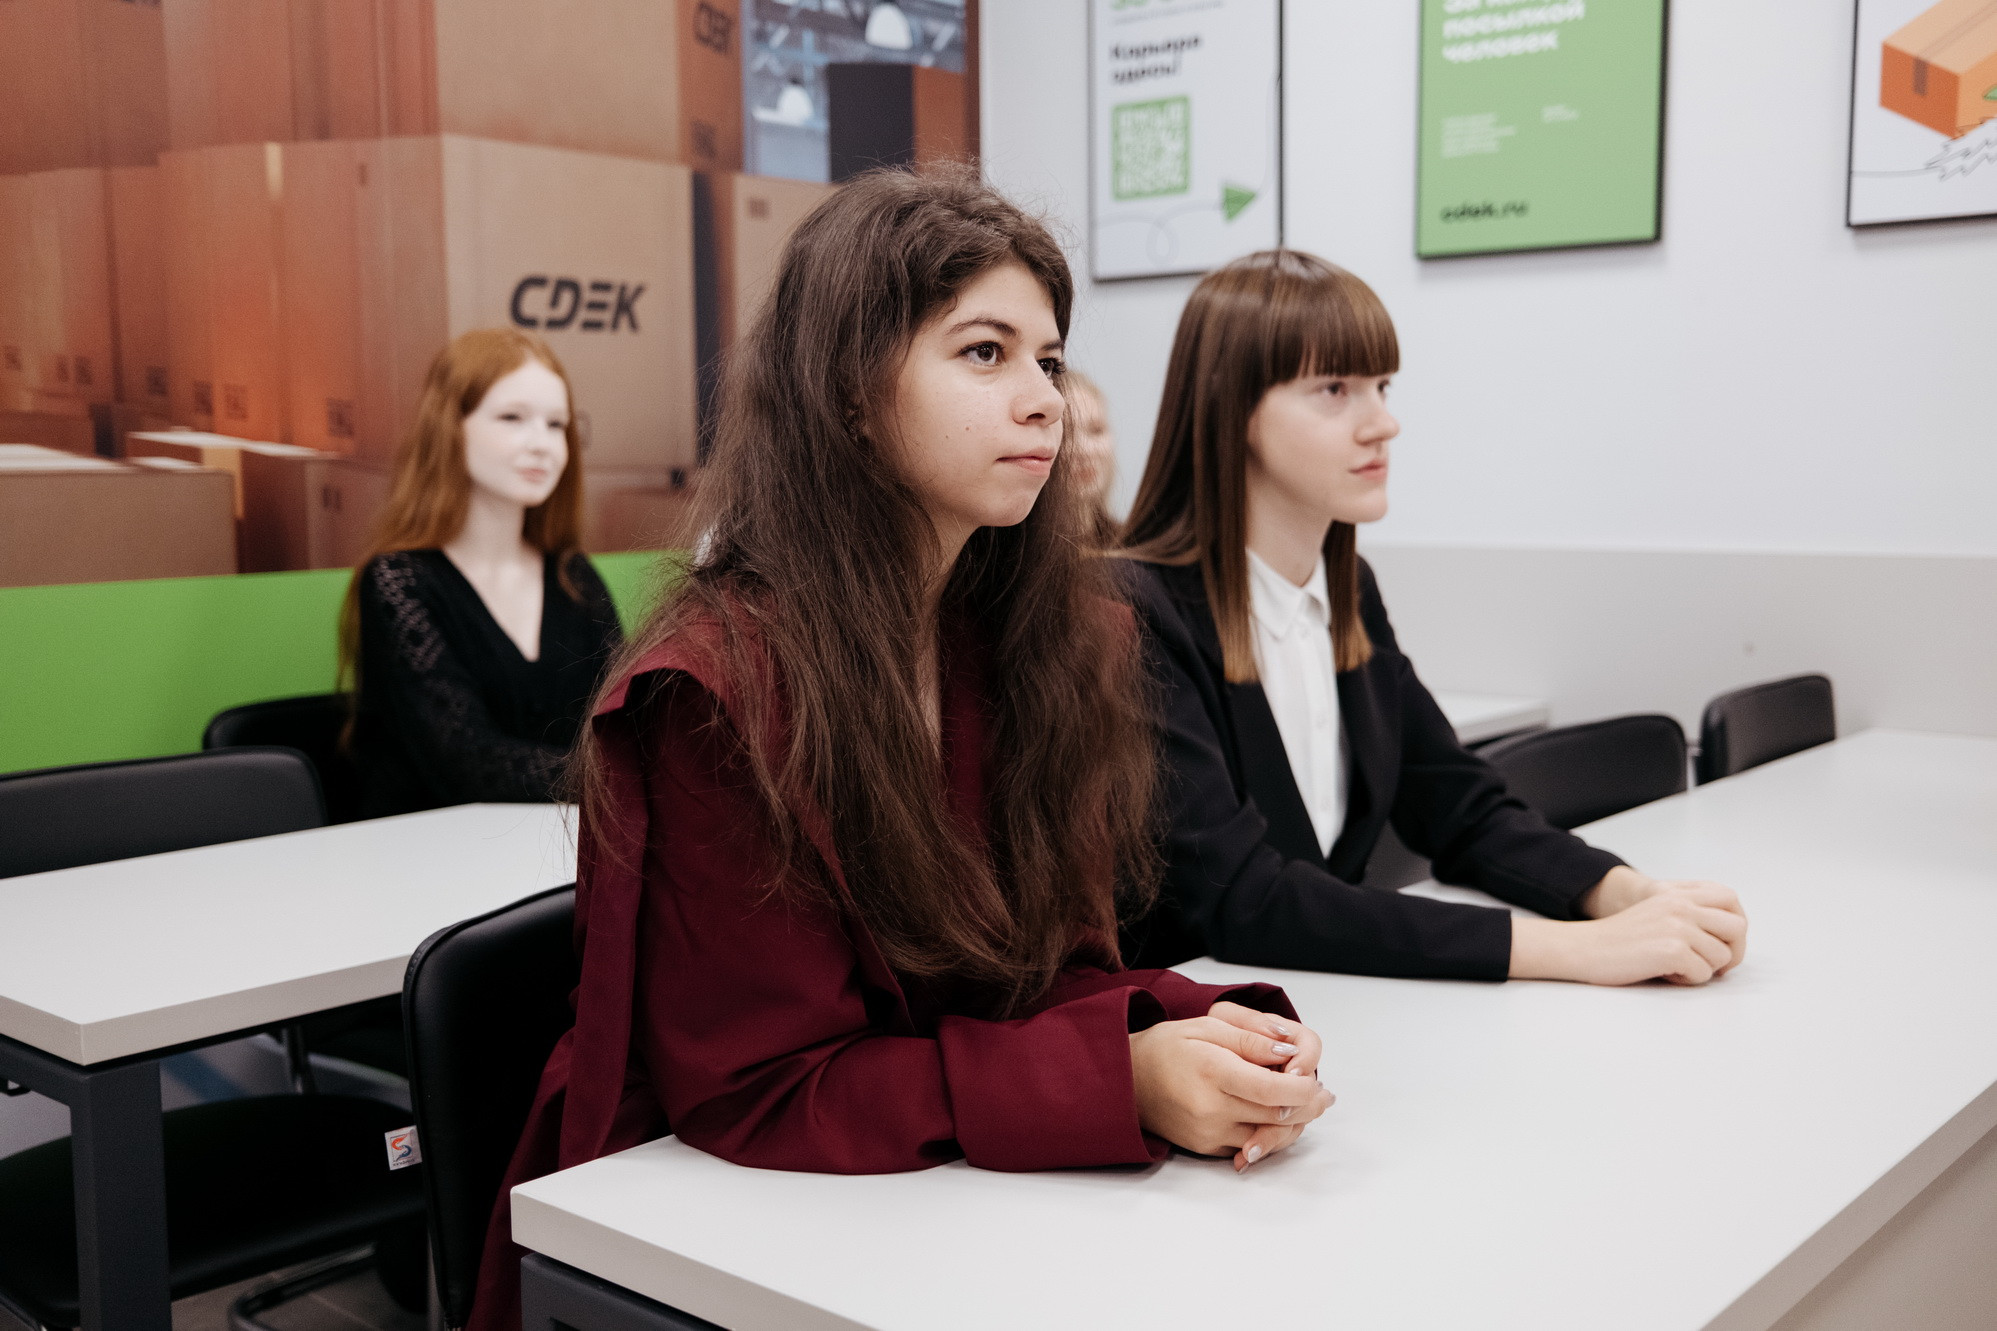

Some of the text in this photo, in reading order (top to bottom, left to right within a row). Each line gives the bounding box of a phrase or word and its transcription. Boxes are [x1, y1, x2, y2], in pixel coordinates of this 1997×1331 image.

[1442, 0, 1585, 39] посылкой
[1441, 29, 1559, 63] человек
[1440, 201, 1529, 223] cdek.ru
[510, 275, 646, 332] CDEK
